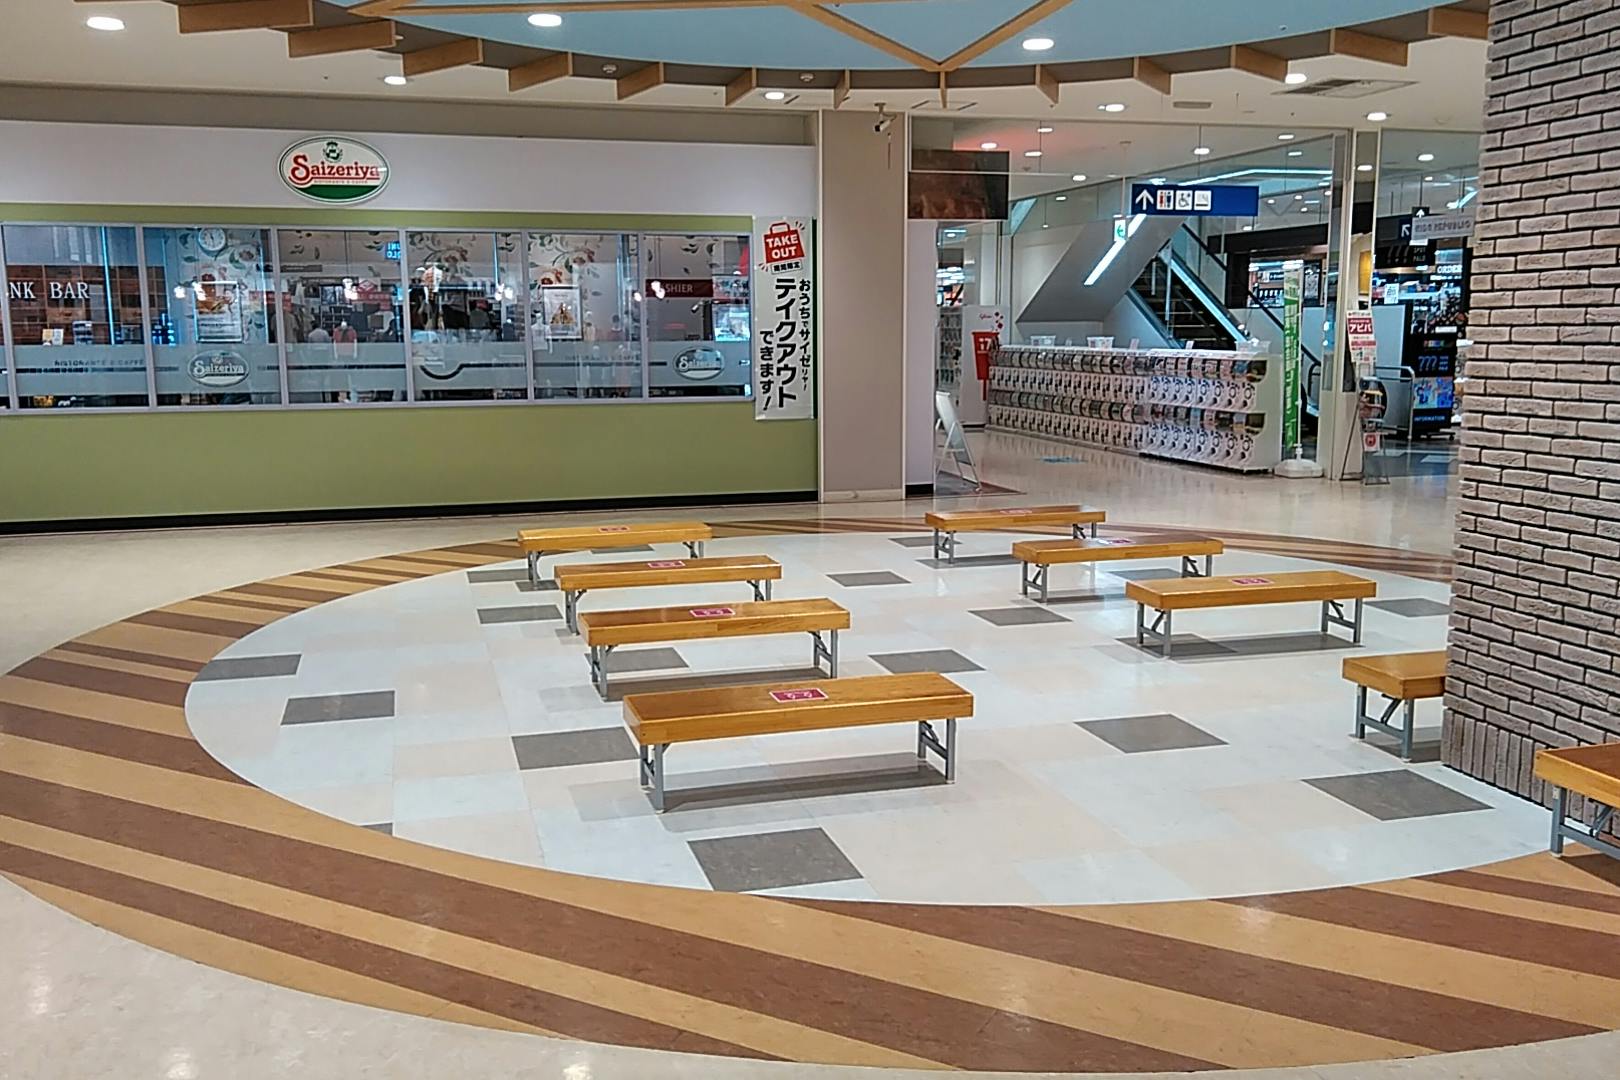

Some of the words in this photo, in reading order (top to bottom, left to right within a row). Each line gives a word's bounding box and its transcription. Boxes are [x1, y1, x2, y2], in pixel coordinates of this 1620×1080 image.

[289, 154, 380, 182] Saizeriya
[766, 234, 798, 248] TAKE
[772, 246, 797, 259] OUT
[8, 282, 36, 298] NK
[50, 282, 90, 298] BAR
[775, 278, 797, 408] テイクアウト
